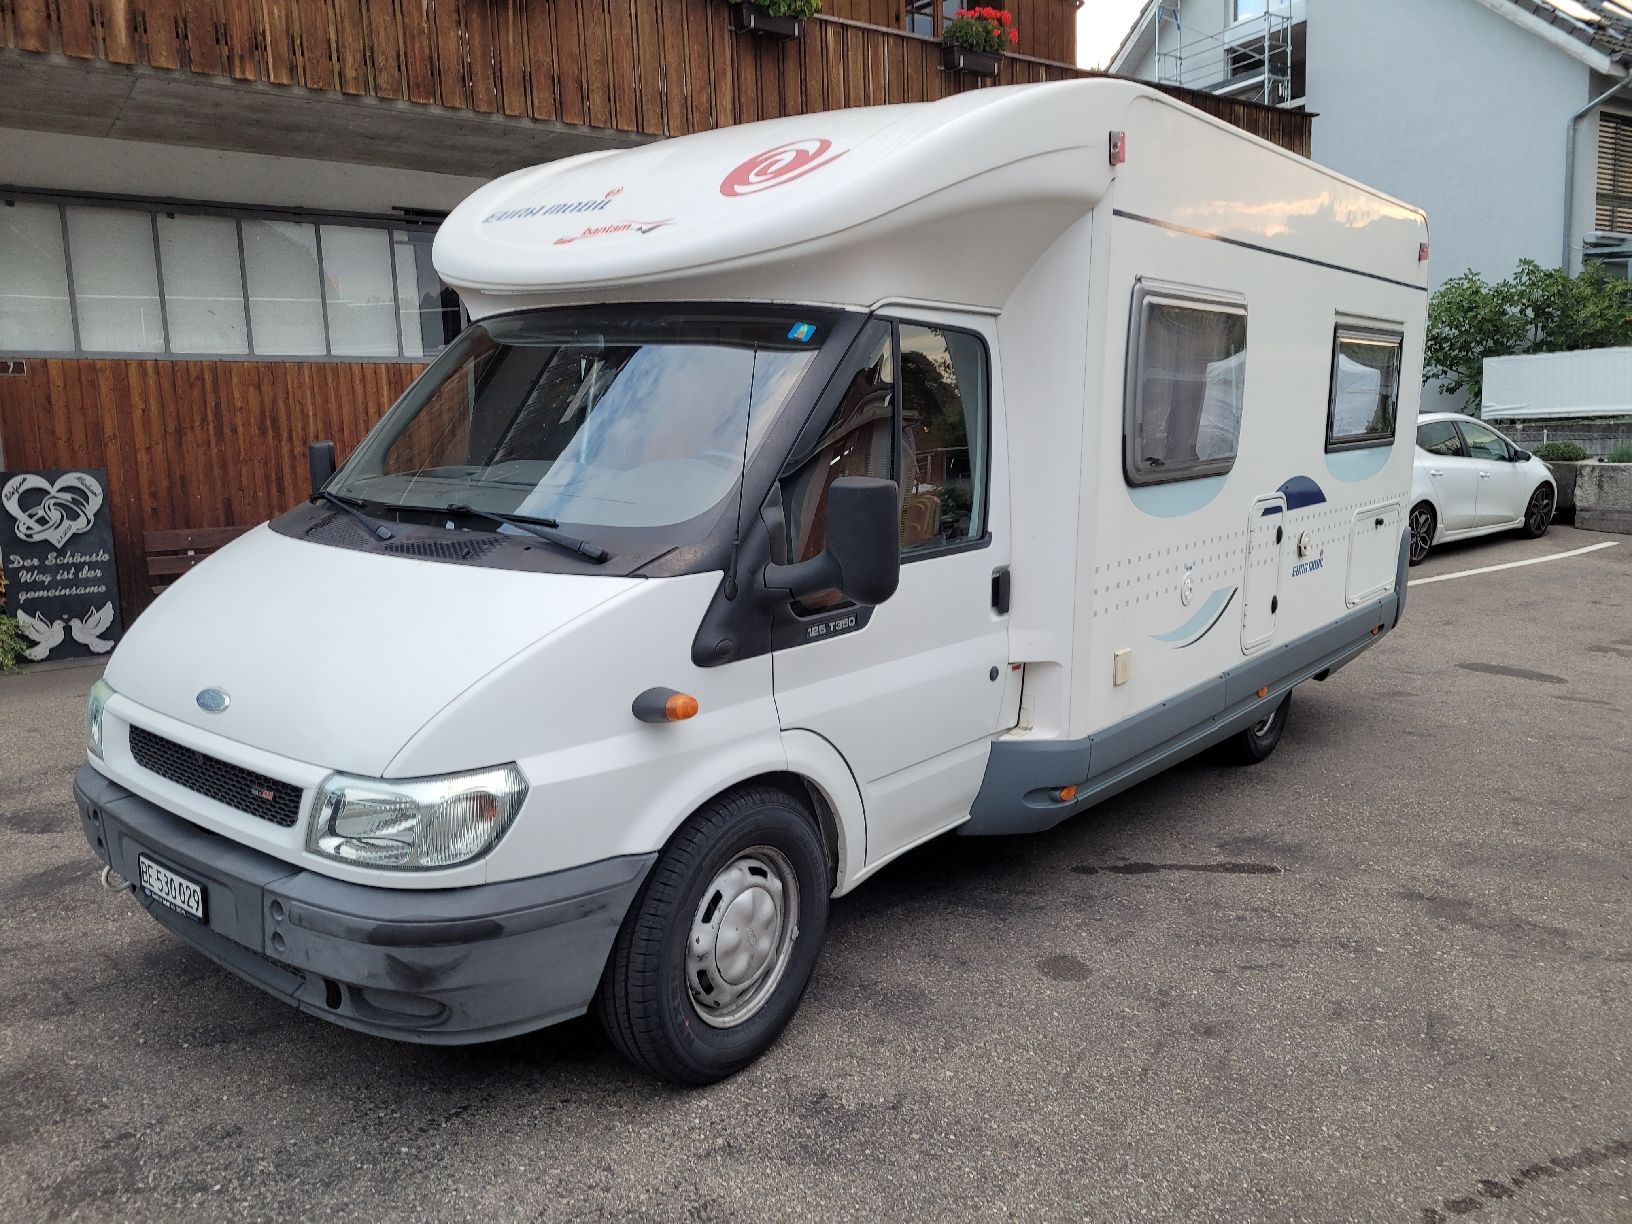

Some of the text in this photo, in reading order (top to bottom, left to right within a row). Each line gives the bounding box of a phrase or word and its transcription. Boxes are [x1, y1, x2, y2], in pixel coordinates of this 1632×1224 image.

[8, 554, 40, 568] Der
[19, 564, 103, 585] Weg ist der
[19, 584, 107, 604] gemeinsame
[829, 616, 856, 631] T350
